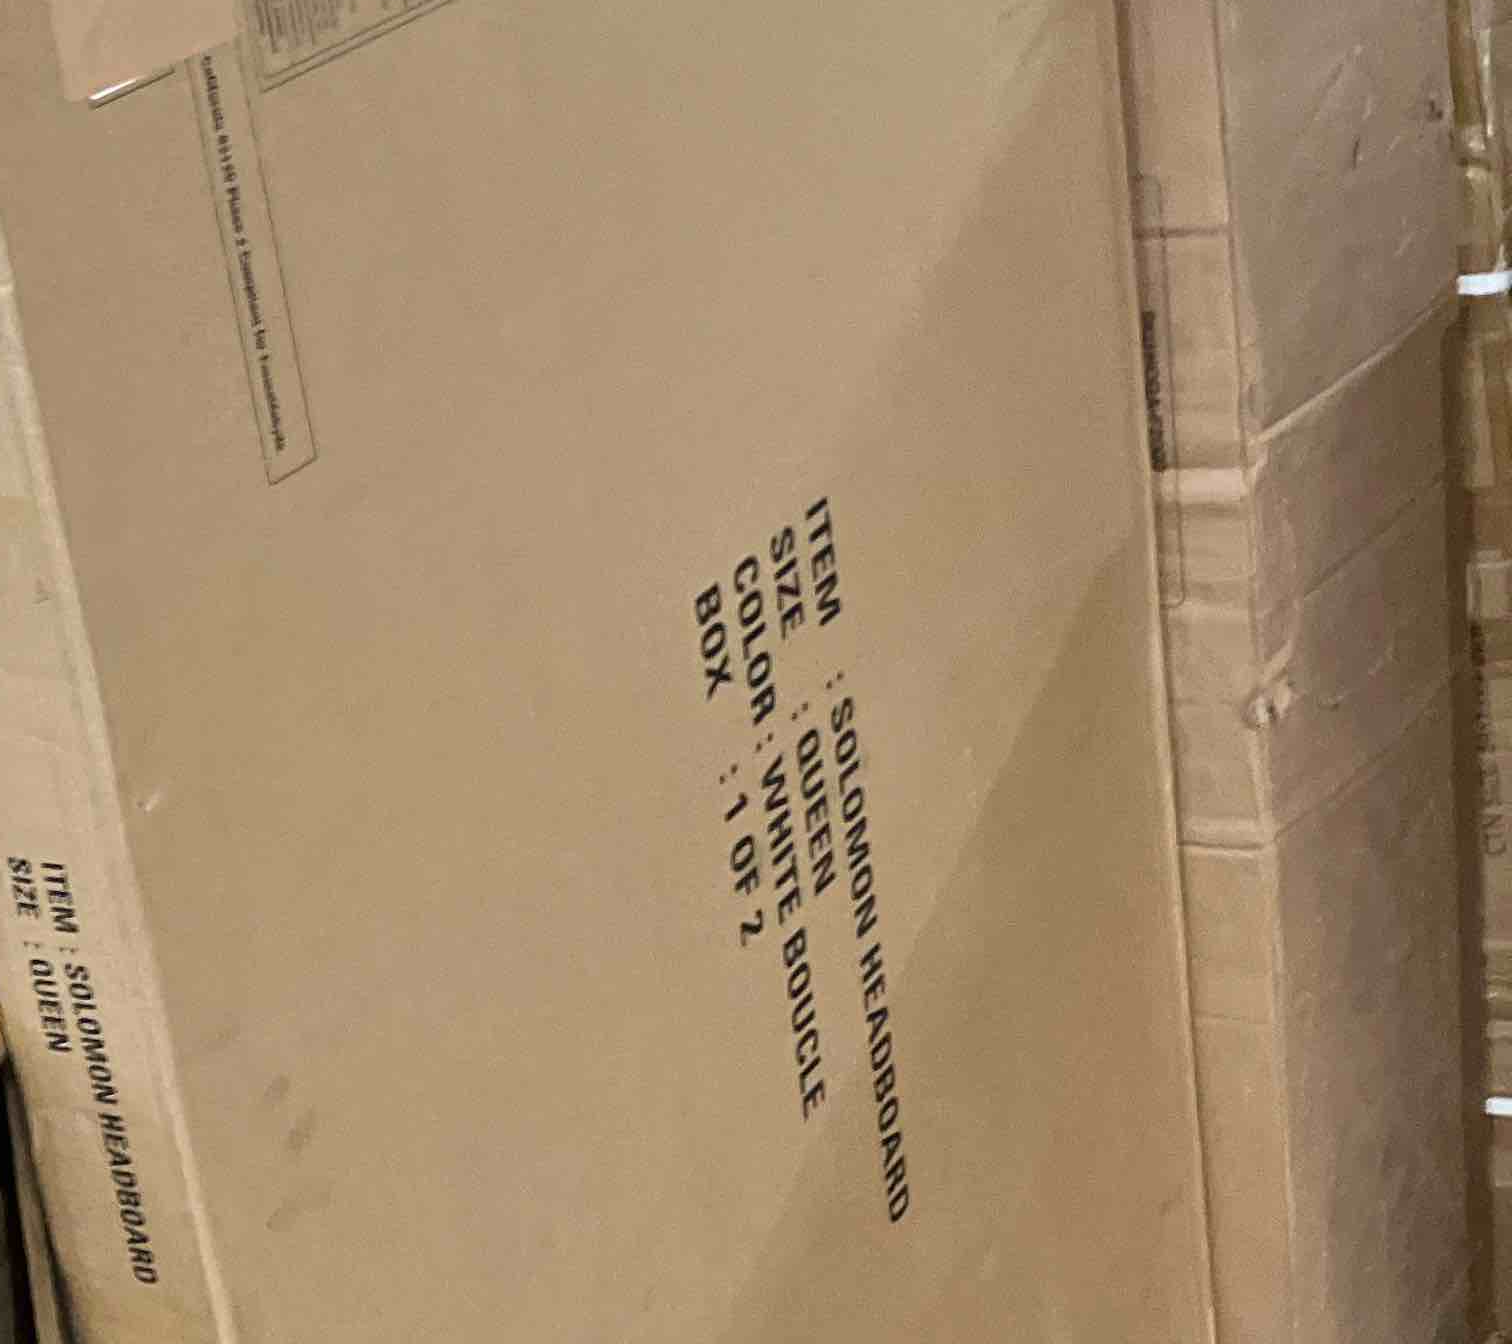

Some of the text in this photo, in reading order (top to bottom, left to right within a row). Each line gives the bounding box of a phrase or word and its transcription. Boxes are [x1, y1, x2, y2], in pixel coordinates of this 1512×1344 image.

[693, 581, 735, 701] BOX
[768, 525, 806, 641] SIZE
[795, 727, 837, 897] QUEEN
[723, 791, 750, 823] 1
[729, 833, 761, 897] OF
[733, 554, 777, 727] COLOR
[760, 751, 803, 927] WHITE
[782, 926, 826, 1123] BOUCLE
[805, 496, 842, 627] ITEM
[830, 696, 878, 940] SOLOMON
[858, 941, 910, 1225] HEADBOARD
[6, 856, 42, 920] SIZE
[28, 958, 73, 1053] QUEEN
[738, 907, 765, 948] 2
[39, 862, 81, 934] ITEM
[63, 962, 120, 1106] SOLOMON
[97, 1111, 160, 1285] HEADBOARD
